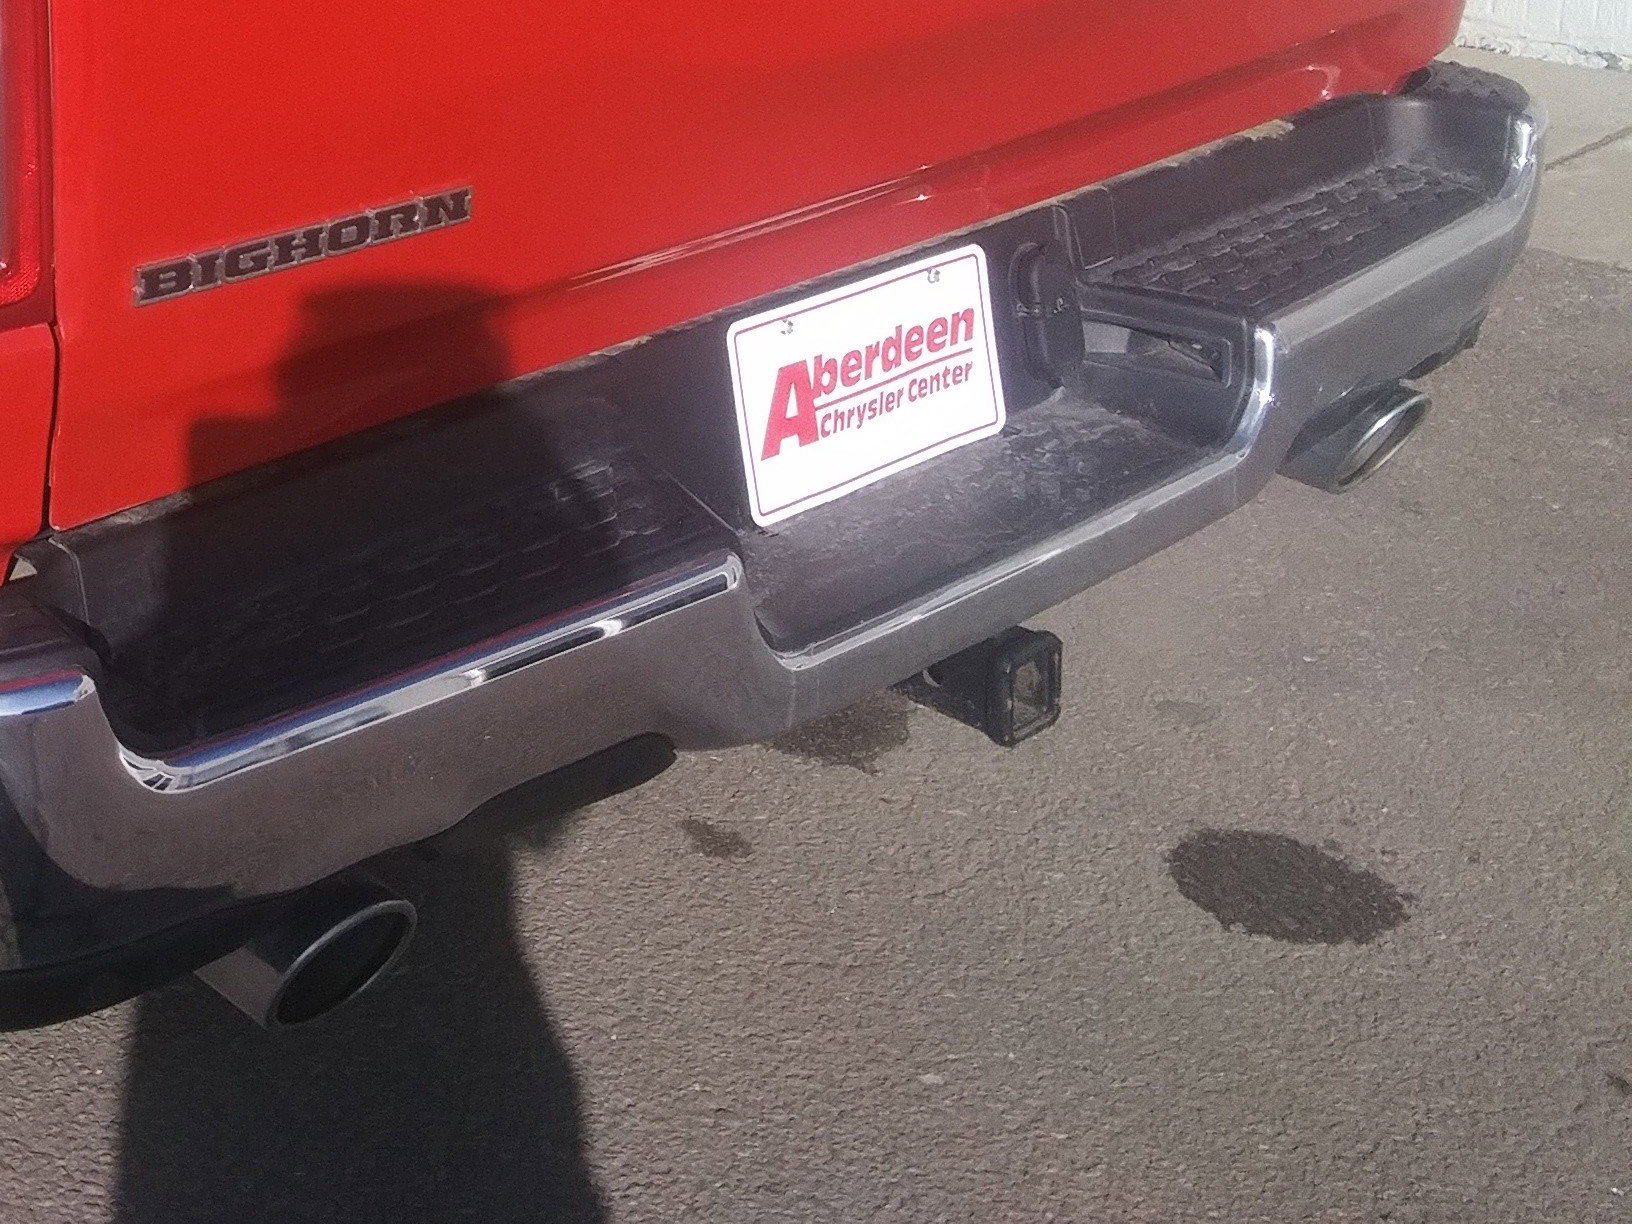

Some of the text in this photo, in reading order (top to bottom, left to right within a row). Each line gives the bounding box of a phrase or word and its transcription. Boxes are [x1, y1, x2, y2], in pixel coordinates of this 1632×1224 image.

[761, 307, 974, 461] Aberdeen
[819, 359, 974, 438] Chrysler Center
